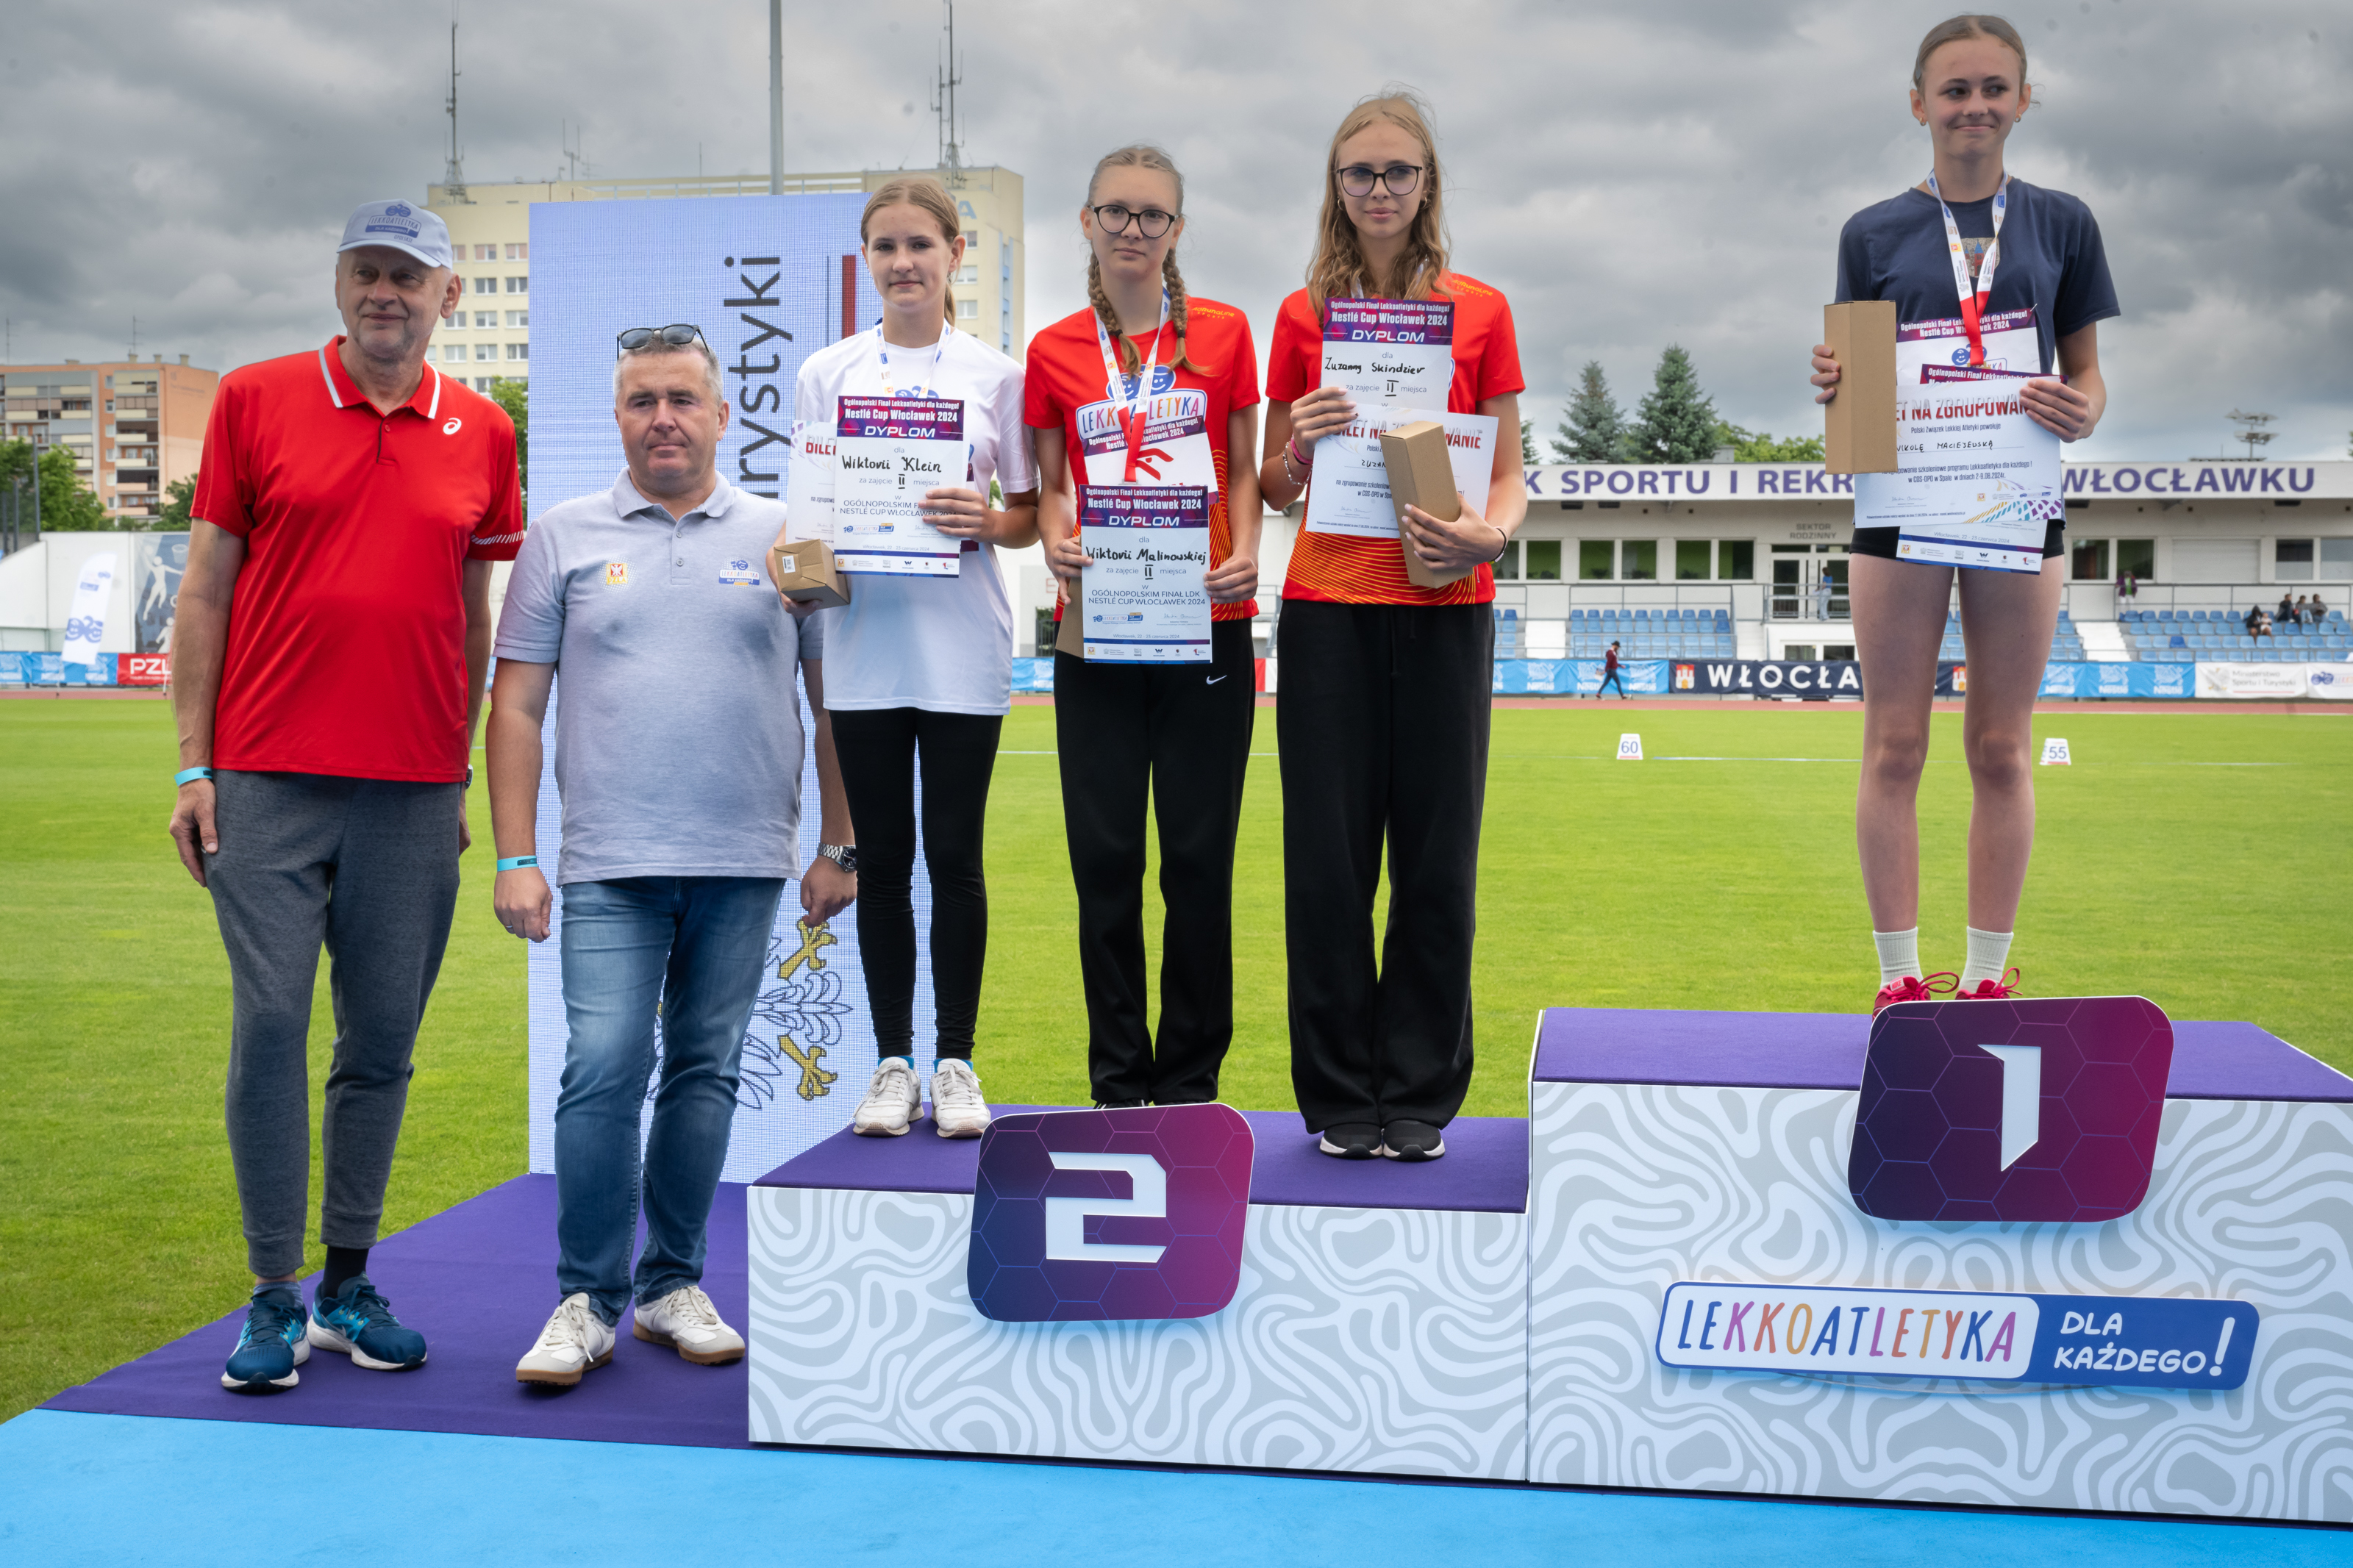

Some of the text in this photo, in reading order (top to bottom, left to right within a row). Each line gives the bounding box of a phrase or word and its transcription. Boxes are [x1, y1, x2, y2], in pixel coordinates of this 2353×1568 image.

[371, 217, 418, 229] LEKKOATLETYKA
[1380, 302, 1415, 312] Lekkoatletyki
[1427, 304, 1449, 312] każdego!
[1332, 312, 1447, 326] Nestlé Cup Włocławek 2024
[1901, 321, 1937, 331] Ogólnopolski
[2002, 310, 2027, 320] każdego!
[1920, 321, 2009, 337] Nestlé Cup 2024
[1352, 330, 1424, 342] DYPLOM
[1929, 368, 1966, 377] Ogólnopolski
[892, 400, 926, 408] Lekkoatletyki
[936, 401, 959, 409] każdego!
[1913, 398, 1931, 420] NA
[845, 409, 957, 422] Nestlé Cup Włocławek 2024
[865, 426, 935, 437] DYPLOM
[1089, 433, 1121, 445] Ogólnopolski
[1176, 418, 1198, 427] każdego!
[1926, 425, 1944, 433] Związek
[1107, 441, 1124, 450] Nestlé
[901, 457, 941, 473] Klein
[1561, 470, 1710, 495] SPORTU
[1729, 470, 1738, 493] I
[1940, 475, 1952, 483] Spale
[2063, 468, 2315, 493] WŁOCŁAWKU
[1134, 490, 1168, 498] Lekkoatletyki
[844, 498, 911, 508] OGÓLNOPOLSKIM
[1088, 498, 1202, 510] Nestlé Cup Włocławek 2024
[840, 506, 868, 515] NESTLÉ
[1109, 516, 1179, 526] DYPLOM
[1934, 531, 1960, 540] Włocławek,
[1137, 548, 1206, 565] Malinowskiej
[1092, 589, 1159, 597] OGÓLNOPOLSKIM
[1707, 665, 1860, 689] WŁOCŁA
[2263, 679, 2296, 687] Turystyki
[1621, 740, 1639, 754] 60
[2049, 746, 2067, 759] 55
[1977, 1045, 2041, 1172] 1
[1046, 1151, 1167, 1263] 2
[2060, 1311, 2123, 1336] DLA
[1677, 1298, 2017, 1364] LEKKOATLETYKA
